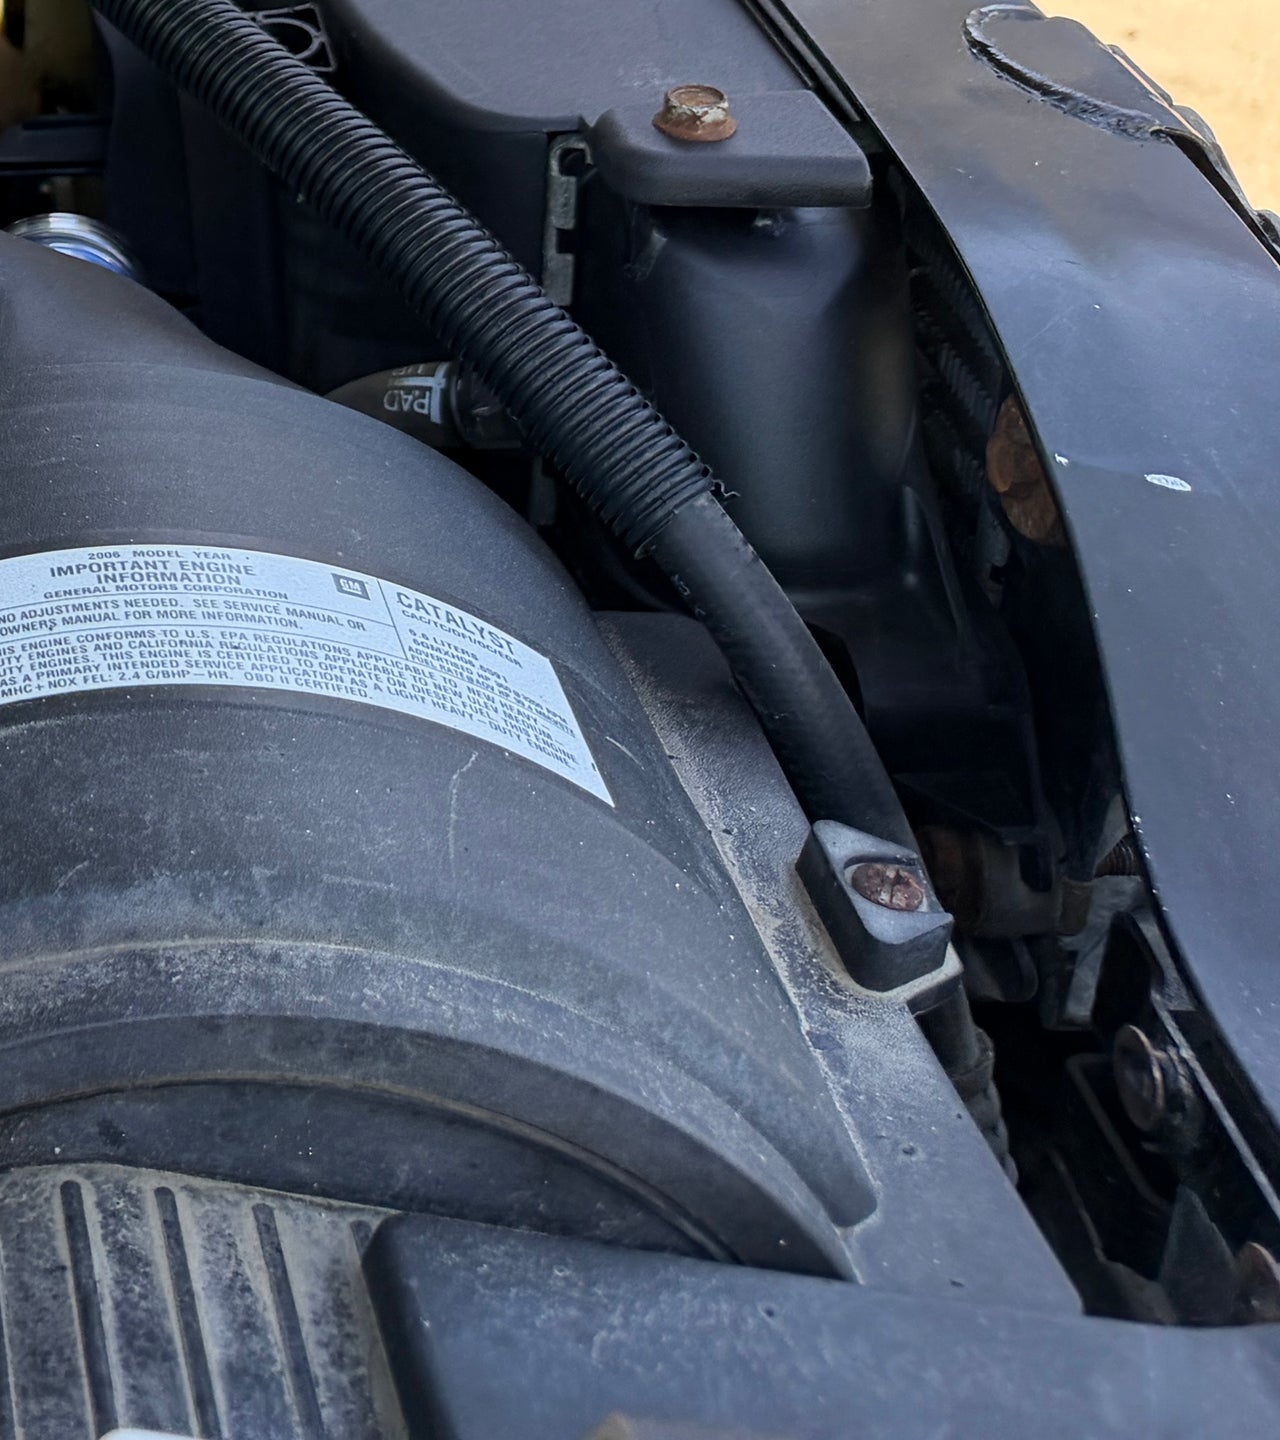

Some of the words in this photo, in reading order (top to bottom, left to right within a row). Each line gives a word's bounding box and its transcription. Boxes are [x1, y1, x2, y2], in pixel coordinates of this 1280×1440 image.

[50, 559, 170, 578] IMPORTANT
[179, 560, 257, 576] ENGINE
[87, 550, 121, 560] 2006
[132, 549, 184, 560] MODEL
[193, 551, 231, 560] YEAR
[43, 585, 111, 600] GENERAL
[115, 583, 179, 593] MOTORS
[183, 583, 289, 601] CORPORATION
[96, 571, 241, 586] INFORMATION
[20, 599, 120, 620] ADJUSTMENTS
[124, 598, 184, 609] NEEDED.
[193, 598, 219, 609] SEE
[224, 600, 281, 615] SERVICE
[285, 607, 345, 627] MANUAL
[347, 620, 366, 632] OR
[62, 612, 121, 626] MANUAL
[125, 610, 152, 621] FOR
[157, 610, 197, 620] MORE
[202, 610, 303, 630] INFORMATION.
[396, 591, 515, 656] CATALYST
[433, 637, 479, 661] LITERS
[21, 634, 72, 652] ENGINE
[76, 629, 157, 643] CONFORMS
[162, 629, 179, 638] TO
[185, 629, 215, 639] U.S.
[220, 631, 249, 641] EPA
[253, 633, 352, 657] REGULATIONS
[357, 650, 441, 681] APPLICABLE
[441, 675, 458, 689] TO
[466, 685, 496, 705] NEW
[22, 674, 32, 683] A
[37, 663, 102, 681] PRIMARY
[107, 659, 180, 671] INTENDED
[184, 660, 245, 671] SERVICE
[250, 662, 345, 684] APPLICATION
[350, 677, 369, 689] AS
[373, 681, 384, 692] A
[388, 686, 427, 704] LIGHT
[28, 643, 88, 663] ENGINES
[93, 640, 123, 652] AND
[128, 639, 214, 650] CALIFORNIA
[219, 640, 319, 661] REGULATIONS
[324, 653, 407, 682] APPLICABLE
[412, 675, 429, 688] TO
[433, 681, 463, 700] NEW
[467, 694, 499, 715] ULEV
[30, 654, 95, 672] ENGINES.
[101, 651, 133, 661] THIS
[140, 649, 191, 659] ENGINE
[198, 650, 211, 658] IS
[217, 650, 291, 666] CERTIFIED
[297, 657, 314, 669] TO
[319, 661, 382, 682] OPERATE
[386, 676, 408, 690] ON
[412, 683, 457, 707] DIESEL
[502, 717, 531, 738] THIS
[83, 672, 113, 684] FEL:
[118, 670, 141, 681] 2.4
[243, 671, 275, 683] OBD
[280, 675, 290, 685] II
[294, 677, 374, 699] CERTIFIED.
